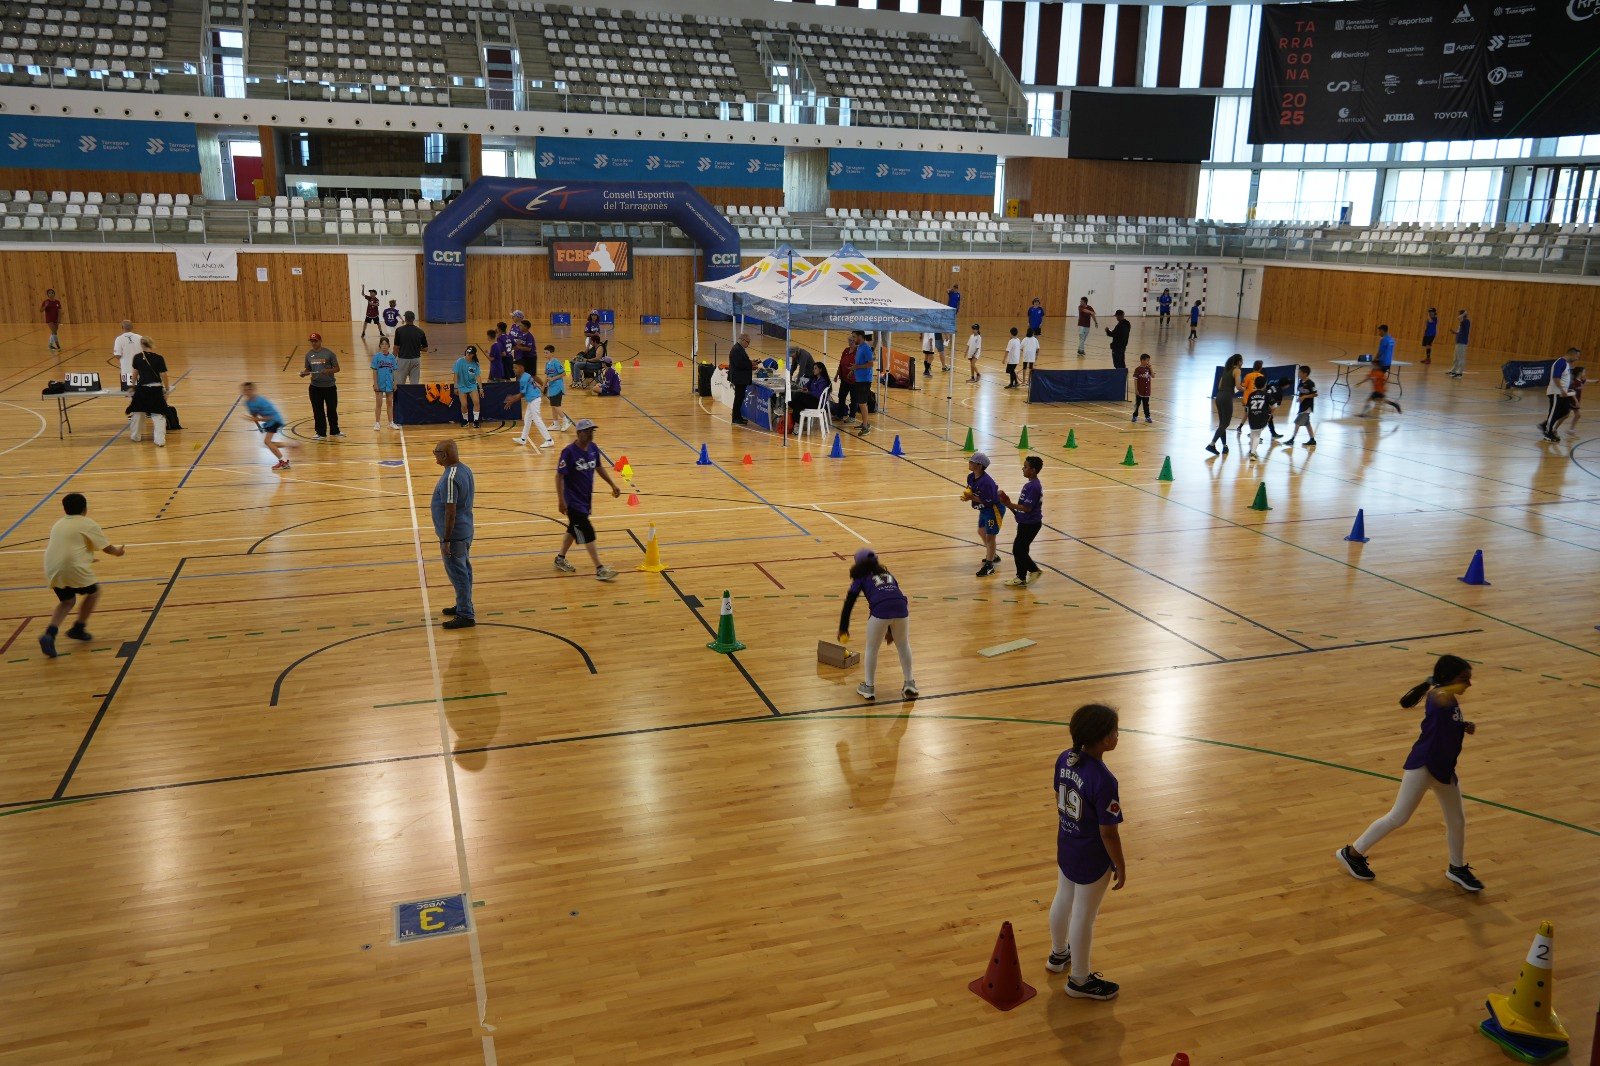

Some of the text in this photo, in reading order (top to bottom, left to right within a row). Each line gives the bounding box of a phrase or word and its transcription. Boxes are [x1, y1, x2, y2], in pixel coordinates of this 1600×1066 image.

[1295, 21, 1315, 32] TA
[1279, 37, 1314, 49] RRA
[1287, 53, 1312, 64] GO
[1286, 69, 1310, 80] NA
[1281, 92, 1307, 108] 20
[1279, 110, 1305, 125] 25
[603, 190, 675, 200] Consell Esportiu
[603, 201, 668, 211] del Tarragonès
[432, 250, 462, 263] CCT
[556, 249, 593, 262] FCBS
[711, 253, 738, 265] CCT
[842, 296, 892, 304] Tarragona
[829, 313, 914, 323] tarragonaesports.cat
[1250, 400, 1265, 410] 27
[1060, 768, 1084, 789] BRION
[1057, 783, 1083, 821] 19
[416, 900, 446, 910] WBSC
[419, 906, 446, 931] 3
[1536, 944, 1550, 961] 2
